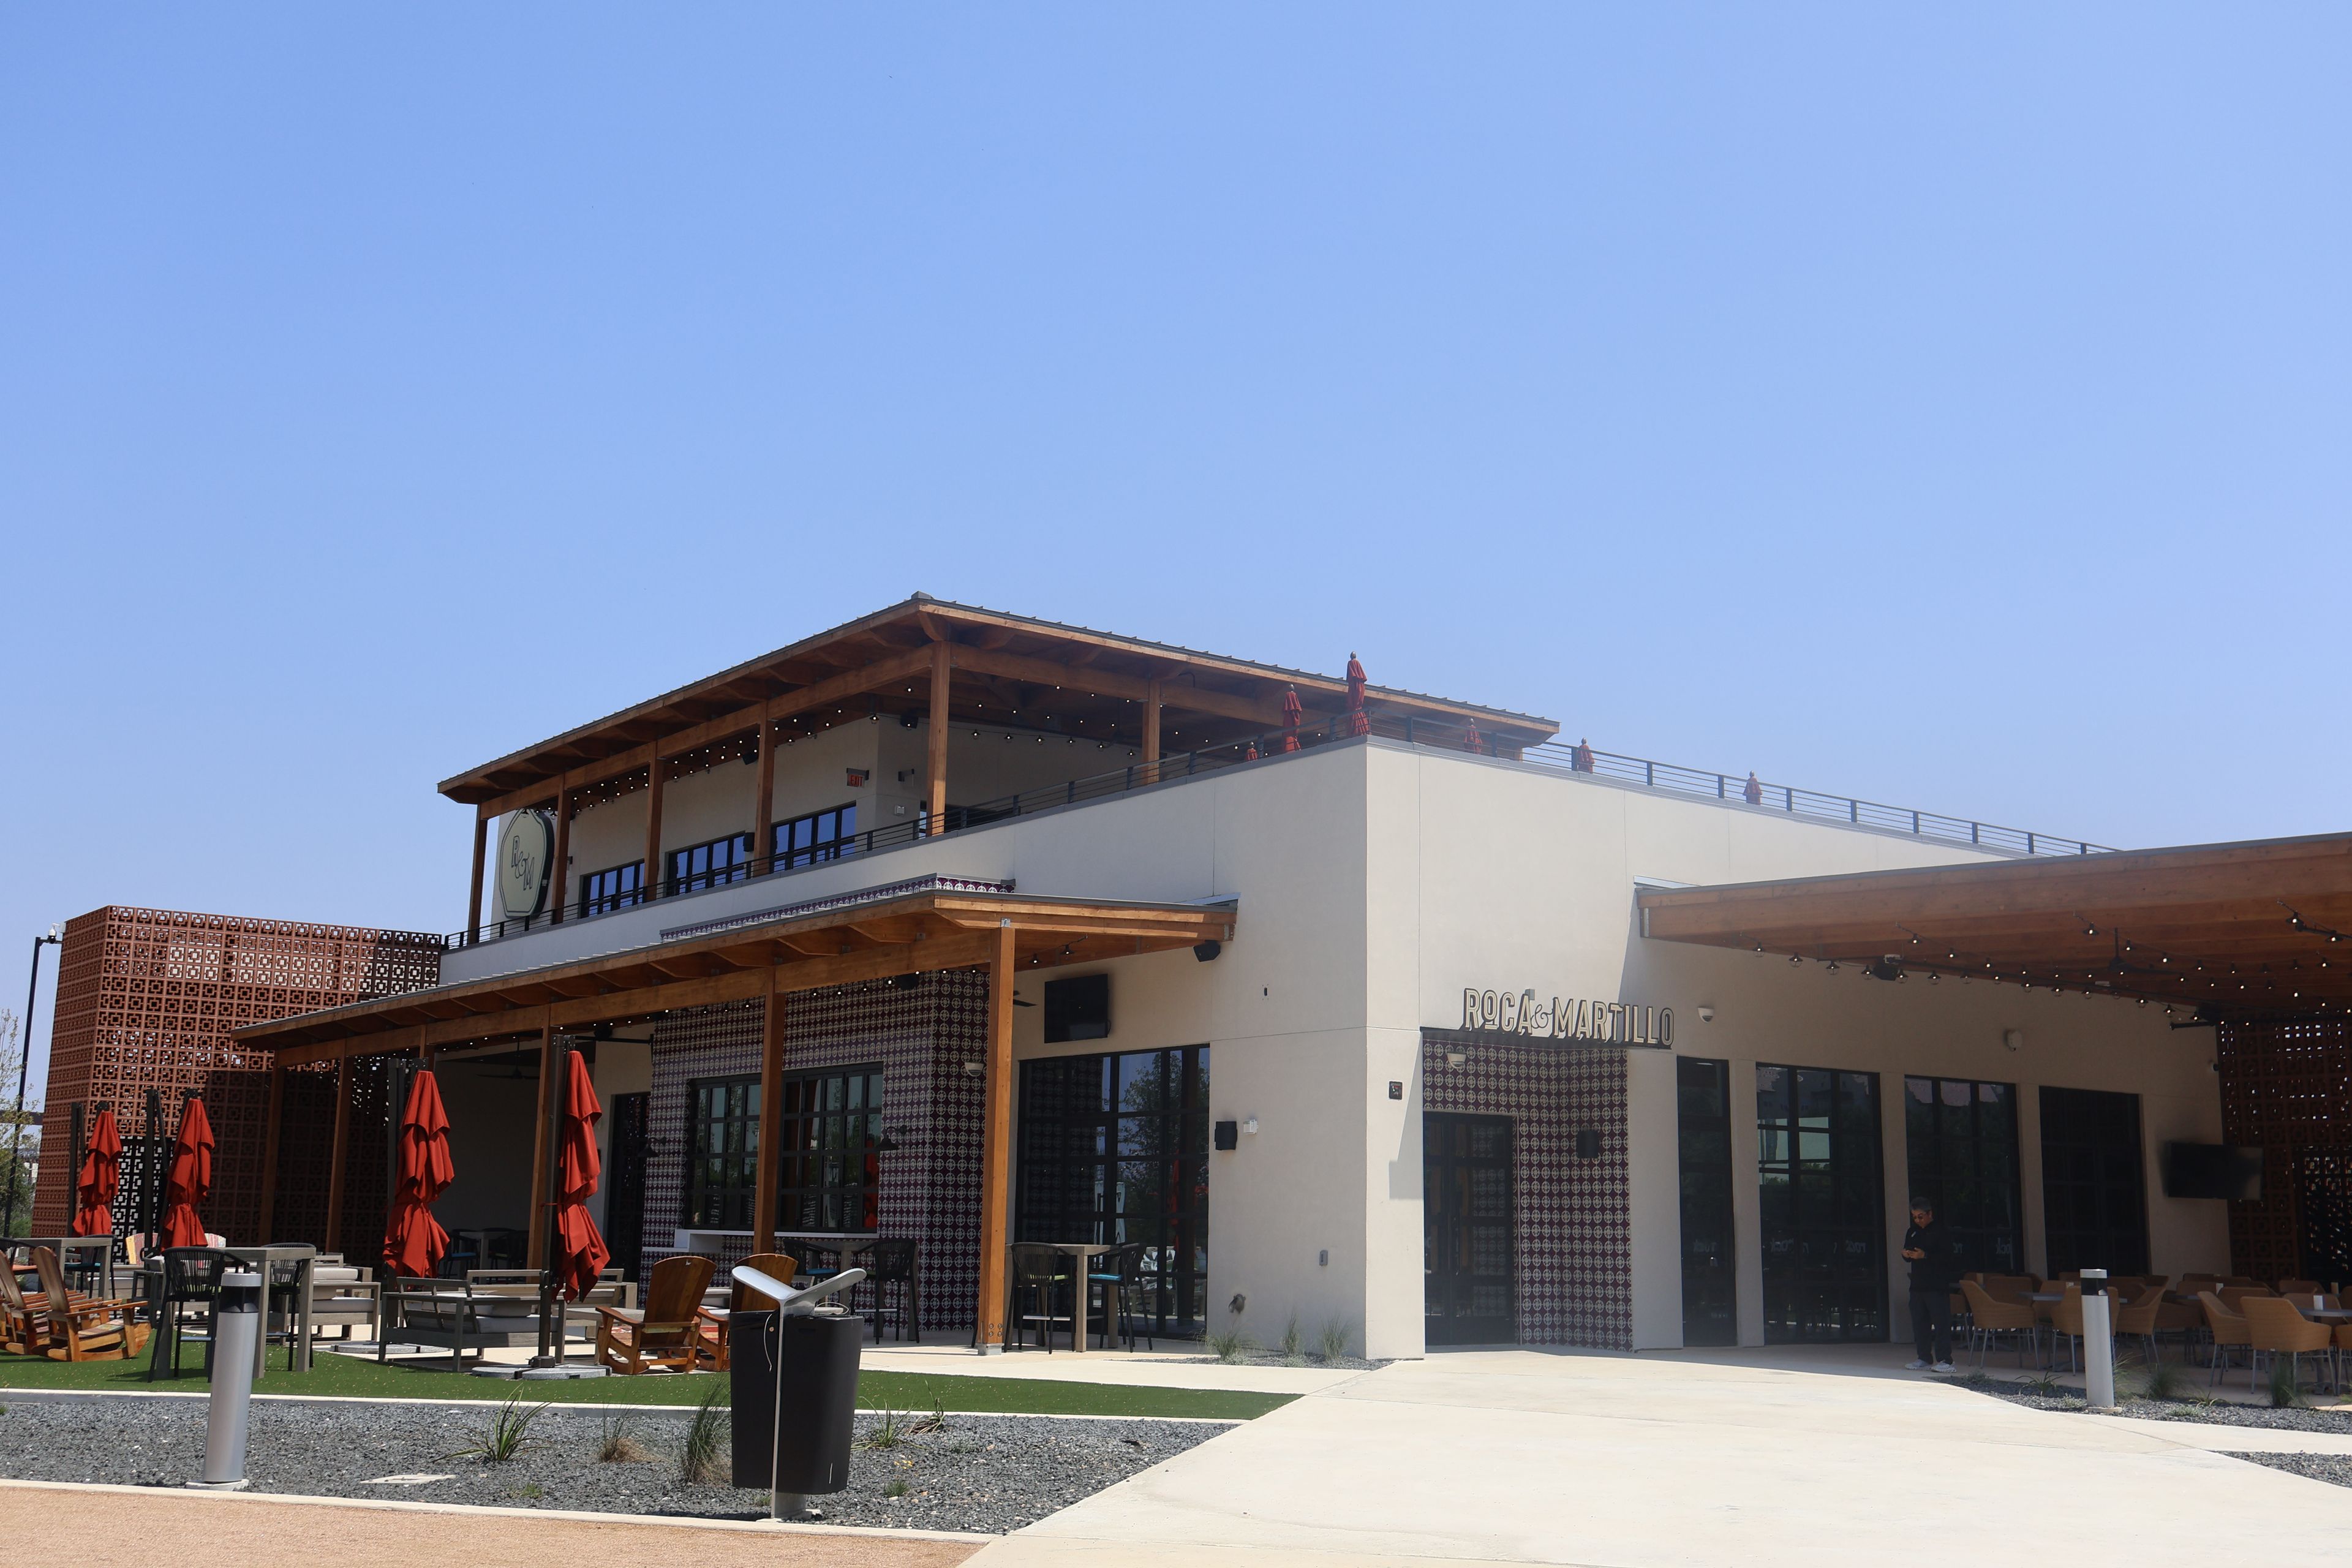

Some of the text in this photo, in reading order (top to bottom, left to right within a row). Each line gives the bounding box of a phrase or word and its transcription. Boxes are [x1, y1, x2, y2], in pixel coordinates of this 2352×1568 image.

[850, 774, 863, 787] EXIT
[1464, 988, 1532, 1035] ROCA
[1553, 997, 1675, 1046] MARTILLO
